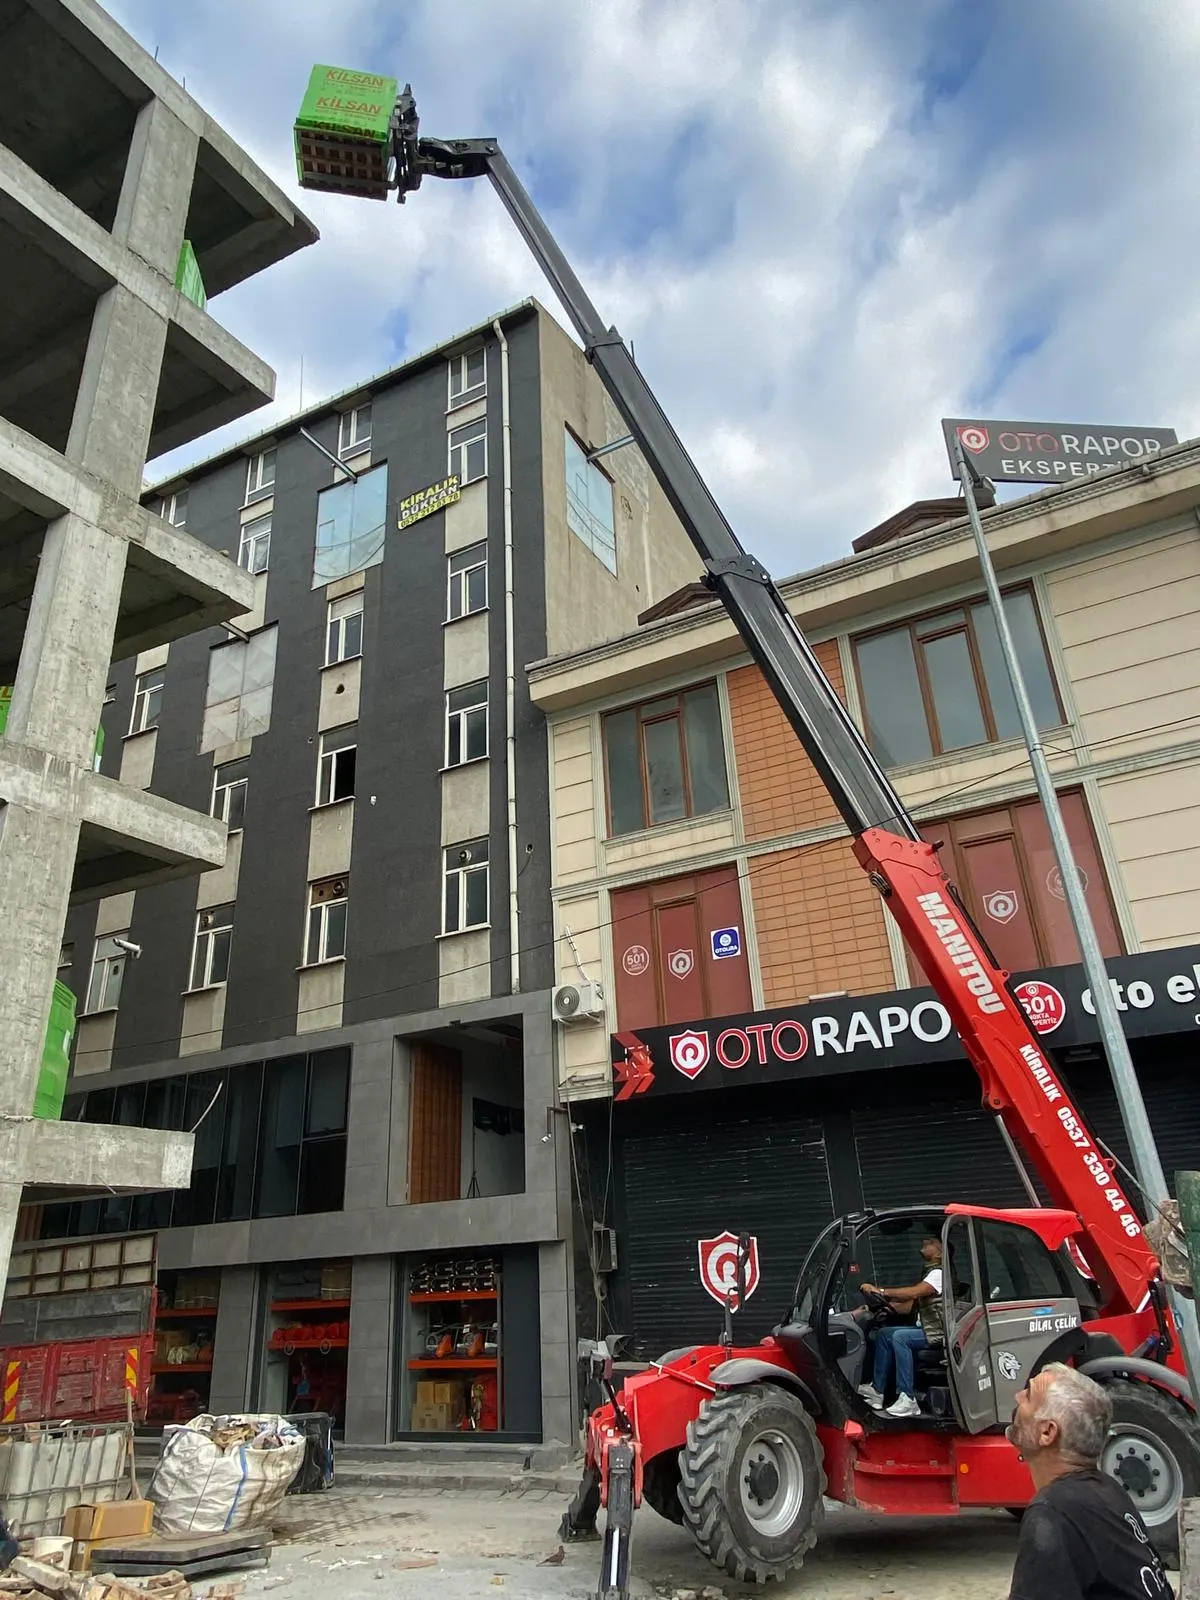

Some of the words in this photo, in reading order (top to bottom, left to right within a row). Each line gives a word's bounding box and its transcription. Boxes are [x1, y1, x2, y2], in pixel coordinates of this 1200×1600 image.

[627, 953, 646, 965] 501
[916, 891, 1006, 1014] MANITOU
[716, 1001, 963, 1069] OTORAPO
[1019, 1043, 1062, 1103] KİRALIK
[1057, 1106, 1091, 1148] 0537
[1083, 1151, 1110, 1186] 330
[1105, 1188, 1126, 1212] 44
[1120, 1212, 1141, 1238] 46
[1029, 1318, 1053, 1332] BİLAL
[1055, 1315, 1077, 1332] ÇELİK
